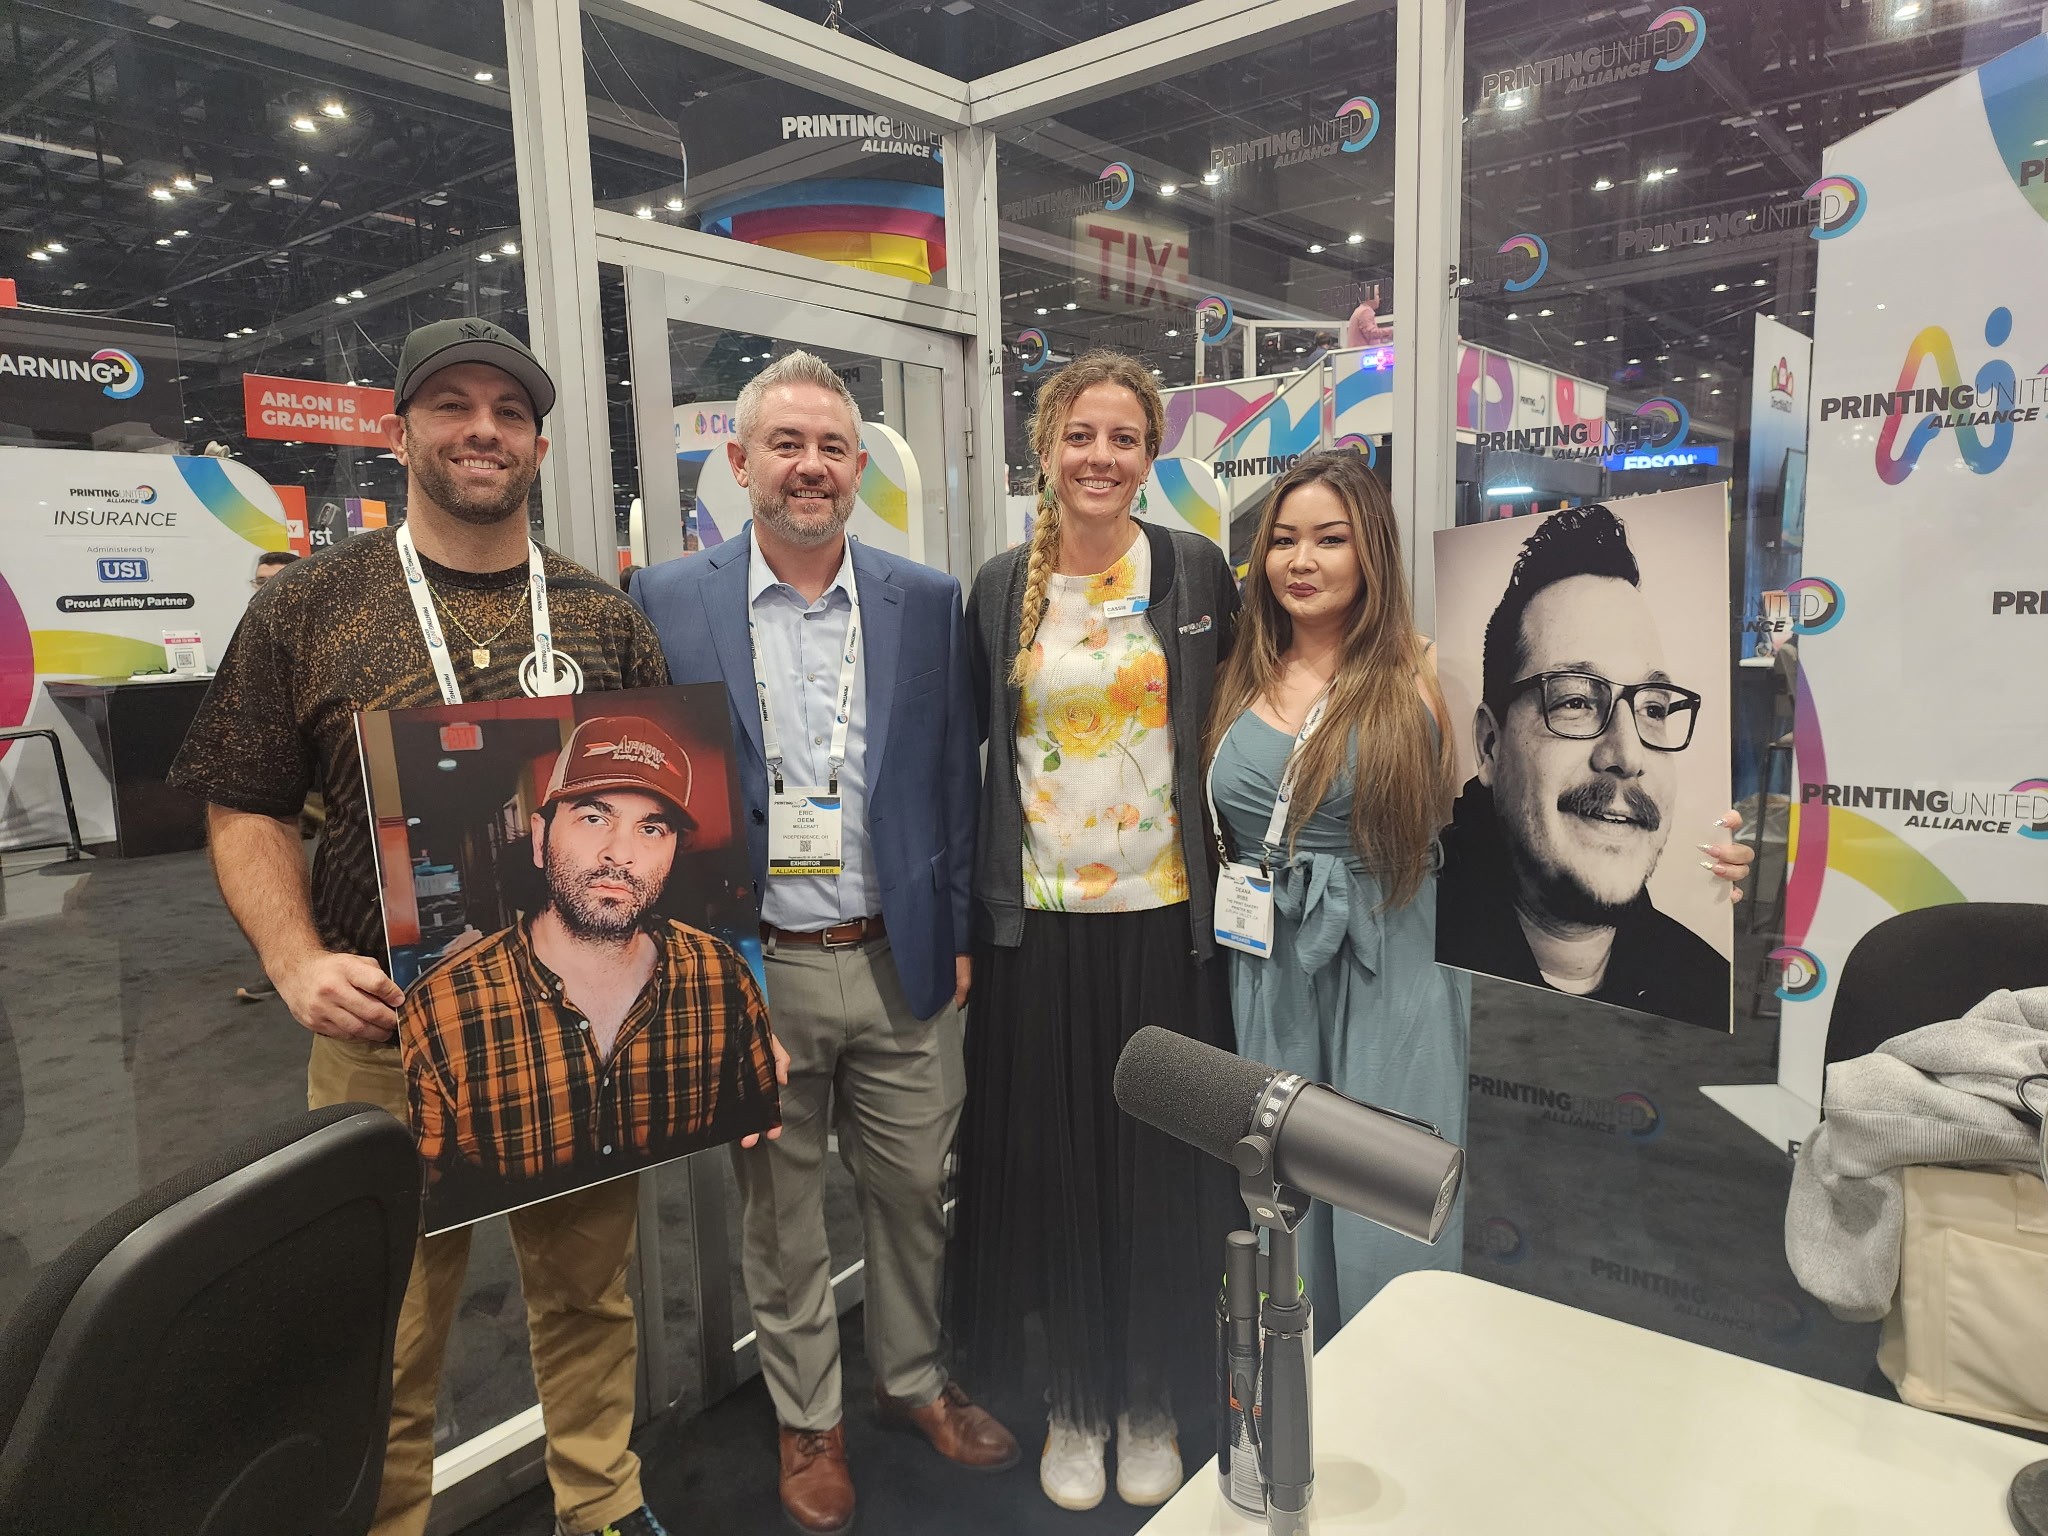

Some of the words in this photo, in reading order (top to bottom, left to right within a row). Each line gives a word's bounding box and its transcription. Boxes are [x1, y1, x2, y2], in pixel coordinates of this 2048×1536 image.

[1565, 60, 1651, 94] ALLIANCE
[861, 139, 930, 158] ALLIANCE
[260, 390, 332, 413] ARLON
[337, 397, 356, 414] IS
[261, 409, 355, 431] GRAPHIC
[1928, 406, 2041, 429] ALLIANCE
[1553, 441, 1637, 461] ALLIANCE
[54, 510, 177, 527] INSURANCE
[144, 546, 155, 555] by
[102, 561, 143, 579] USI
[65, 598, 100, 609] Proud
[103, 597, 145, 609] Affinity
[147, 596, 188, 607] Partner
[1904, 815, 2012, 834] ALLIANCE
